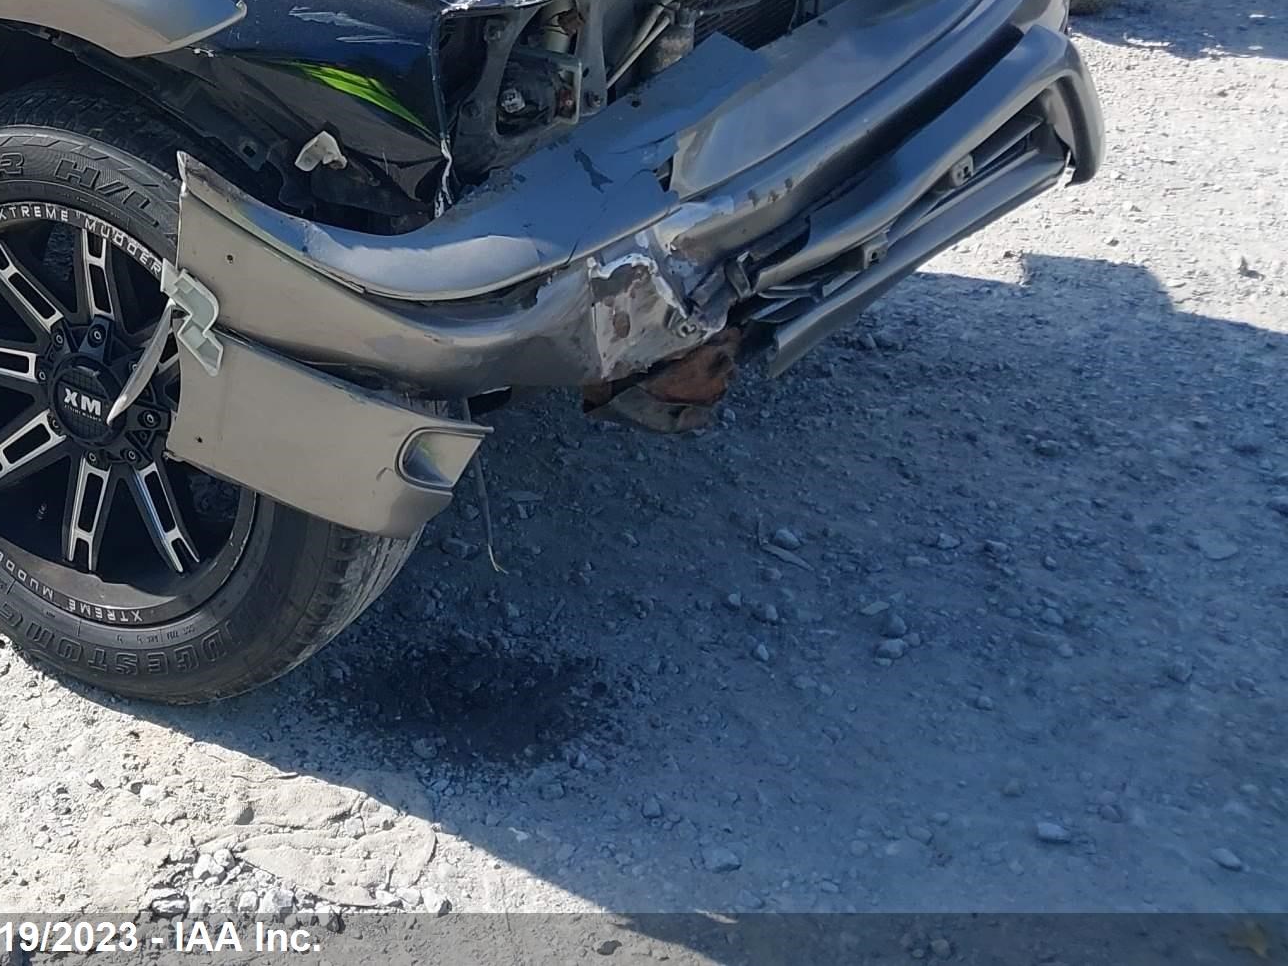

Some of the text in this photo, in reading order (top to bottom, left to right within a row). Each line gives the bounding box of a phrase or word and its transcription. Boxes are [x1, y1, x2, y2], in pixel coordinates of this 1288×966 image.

[84, 217, 162, 277] MUDDER
[64, 387, 102, 417] XM
[67, 597, 143, 623] XTREME
